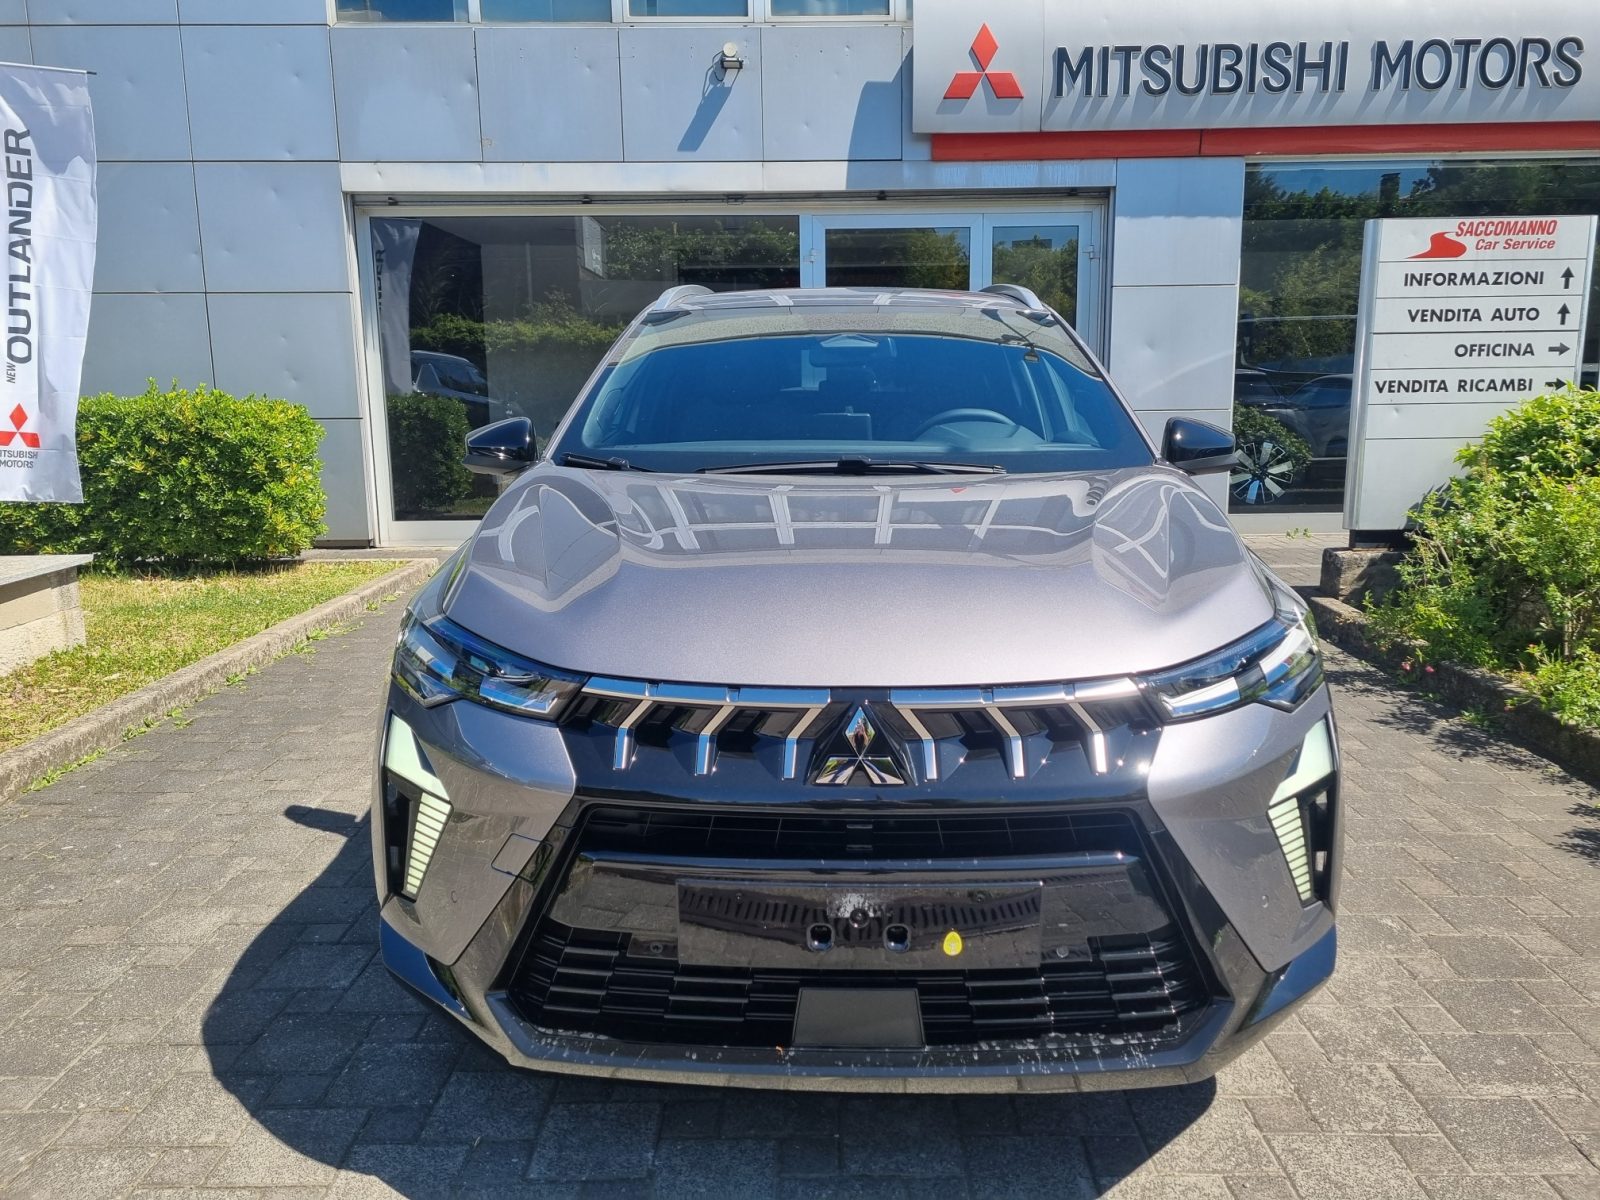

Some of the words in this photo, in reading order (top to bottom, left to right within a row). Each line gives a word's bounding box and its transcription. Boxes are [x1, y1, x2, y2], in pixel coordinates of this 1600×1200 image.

[1055, 41, 1349, 98] MITSUBISHI
[1372, 36, 1585, 91] MOTORS
[1455, 220, 1558, 237] SACCOMANNO
[4, 129, 33, 364] OUTLANDER
[1475, 238, 1499, 250] Car
[1503, 238, 1555, 250] Service
[1404, 271, 1544, 286] INFORMAZIONI
[1407, 308, 1482, 323] VENDITA
[1490, 307, 1540, 322] AUTO
[1454, 343, 1535, 357] OFFICINA
[6, 362, 16, 384] NEW
[1375, 379, 1449, 394] VENDITA
[1457, 378, 1533, 393] RICAMBI
[0, 459, 34, 469] MOTORS
